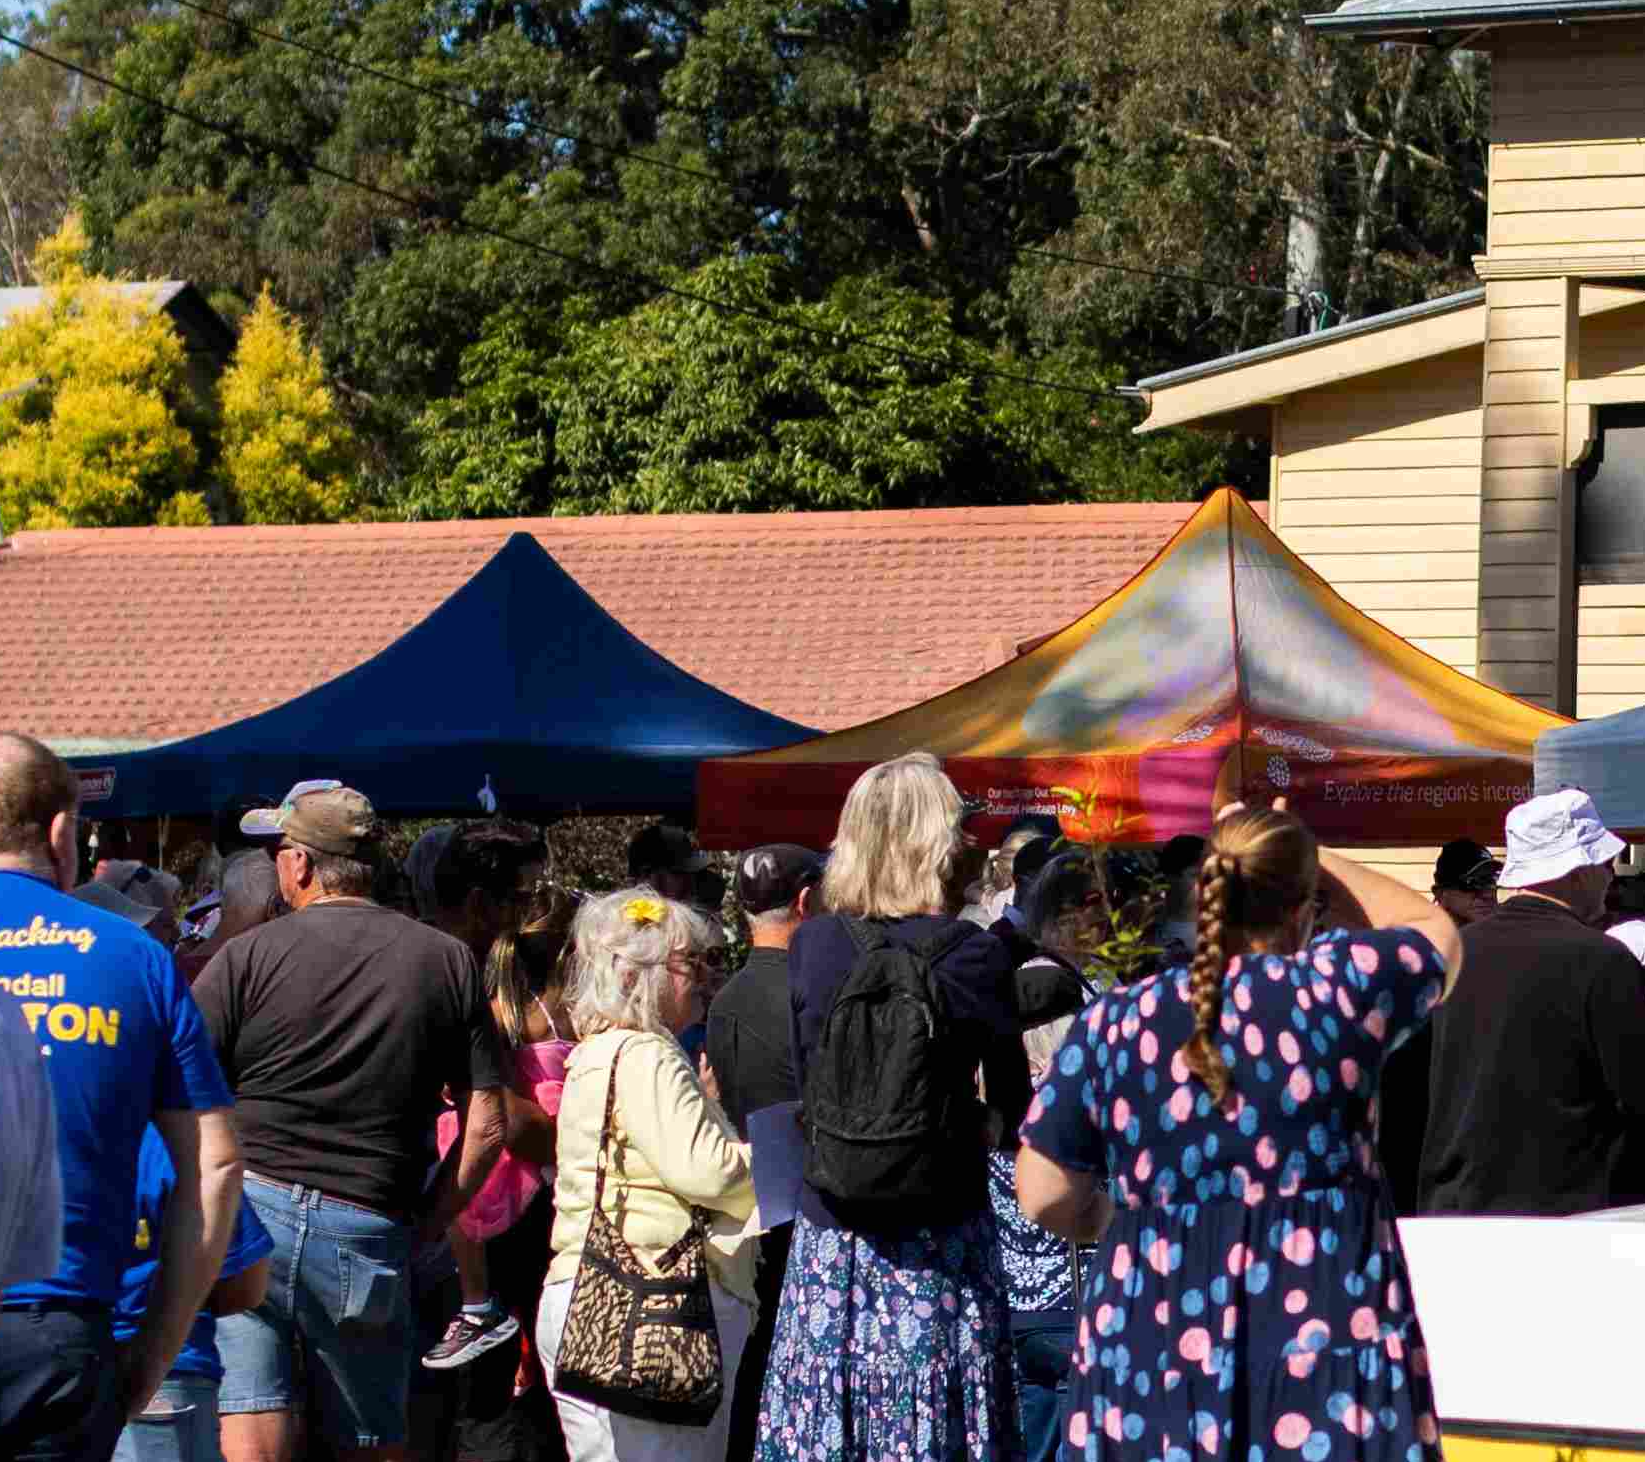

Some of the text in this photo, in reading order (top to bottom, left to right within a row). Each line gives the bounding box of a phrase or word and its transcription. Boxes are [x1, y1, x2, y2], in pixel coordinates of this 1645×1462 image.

[1322, 778, 1382, 807] Explore
[1386, 781, 1413, 803] the
[1416, 779, 1478, 808] region's
